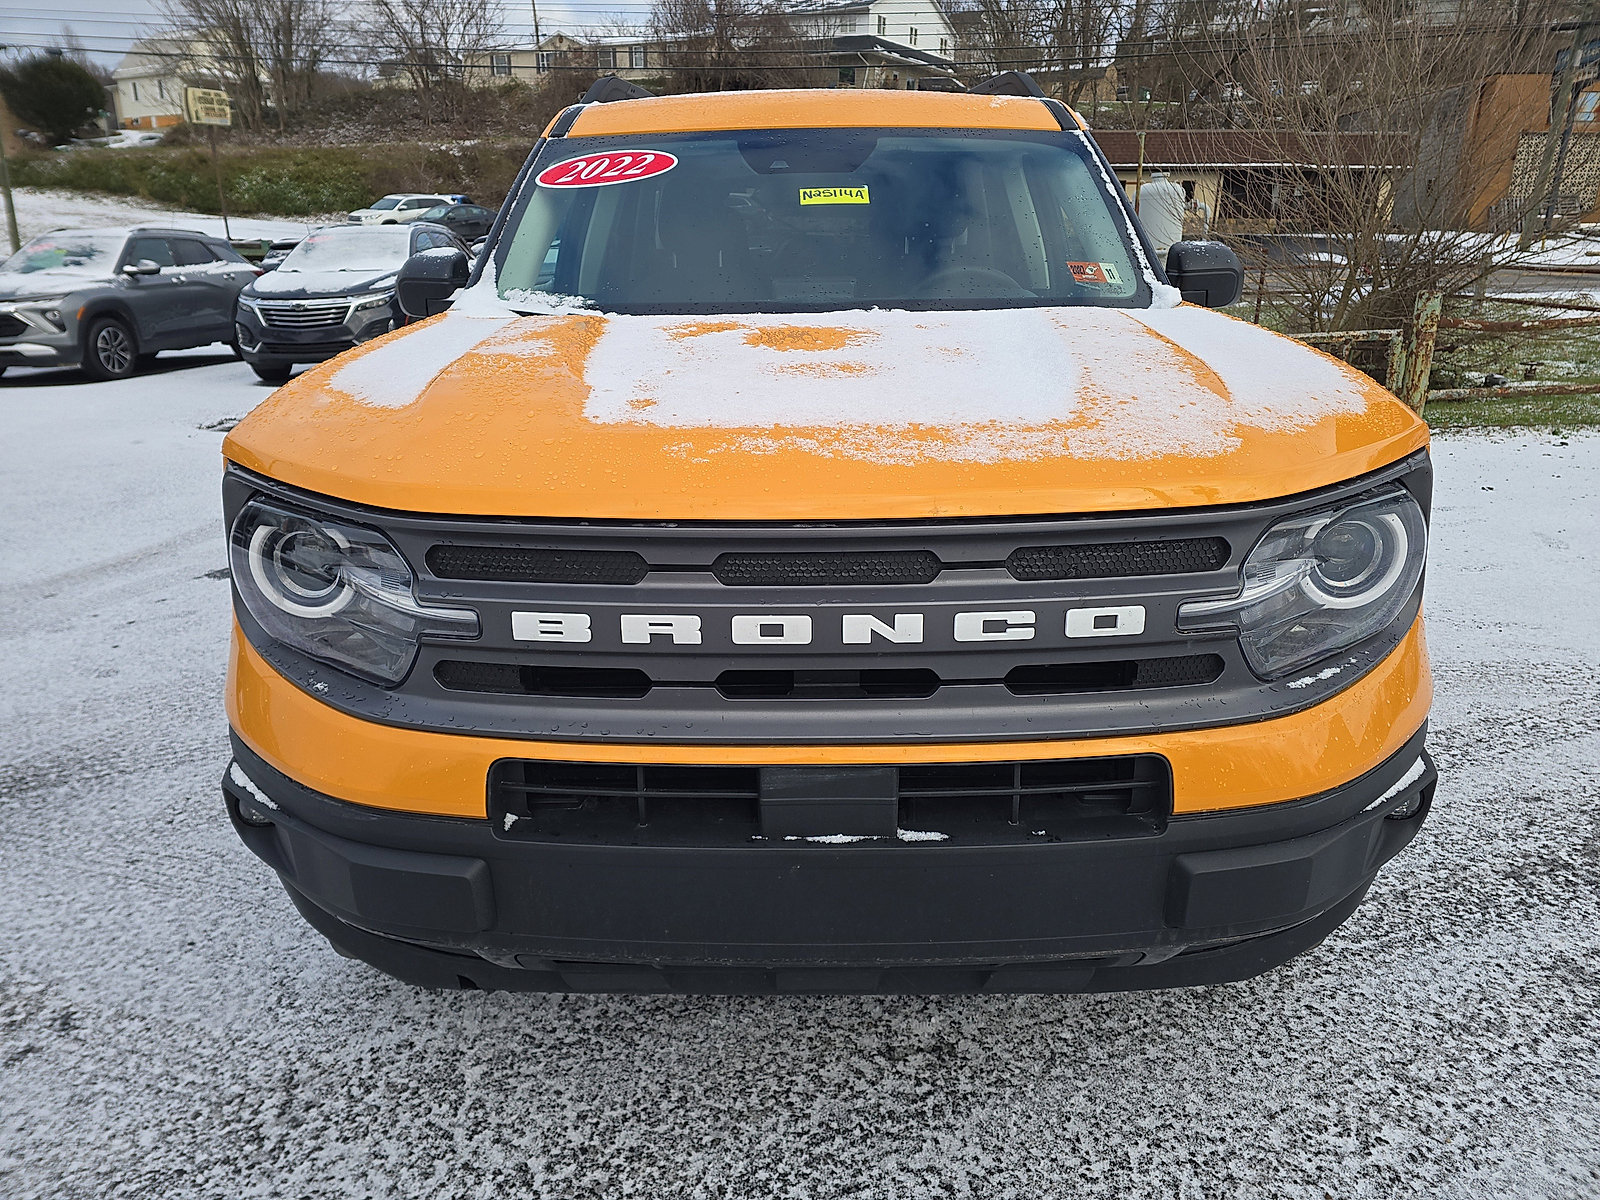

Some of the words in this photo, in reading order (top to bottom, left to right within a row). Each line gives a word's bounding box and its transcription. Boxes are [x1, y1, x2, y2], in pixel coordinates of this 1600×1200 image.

[554, 154, 655, 183] 2022
[802, 184, 865, 201] N25114A
[1105, 268, 1116, 280] 11
[511, 605, 1147, 645] BRONCO
